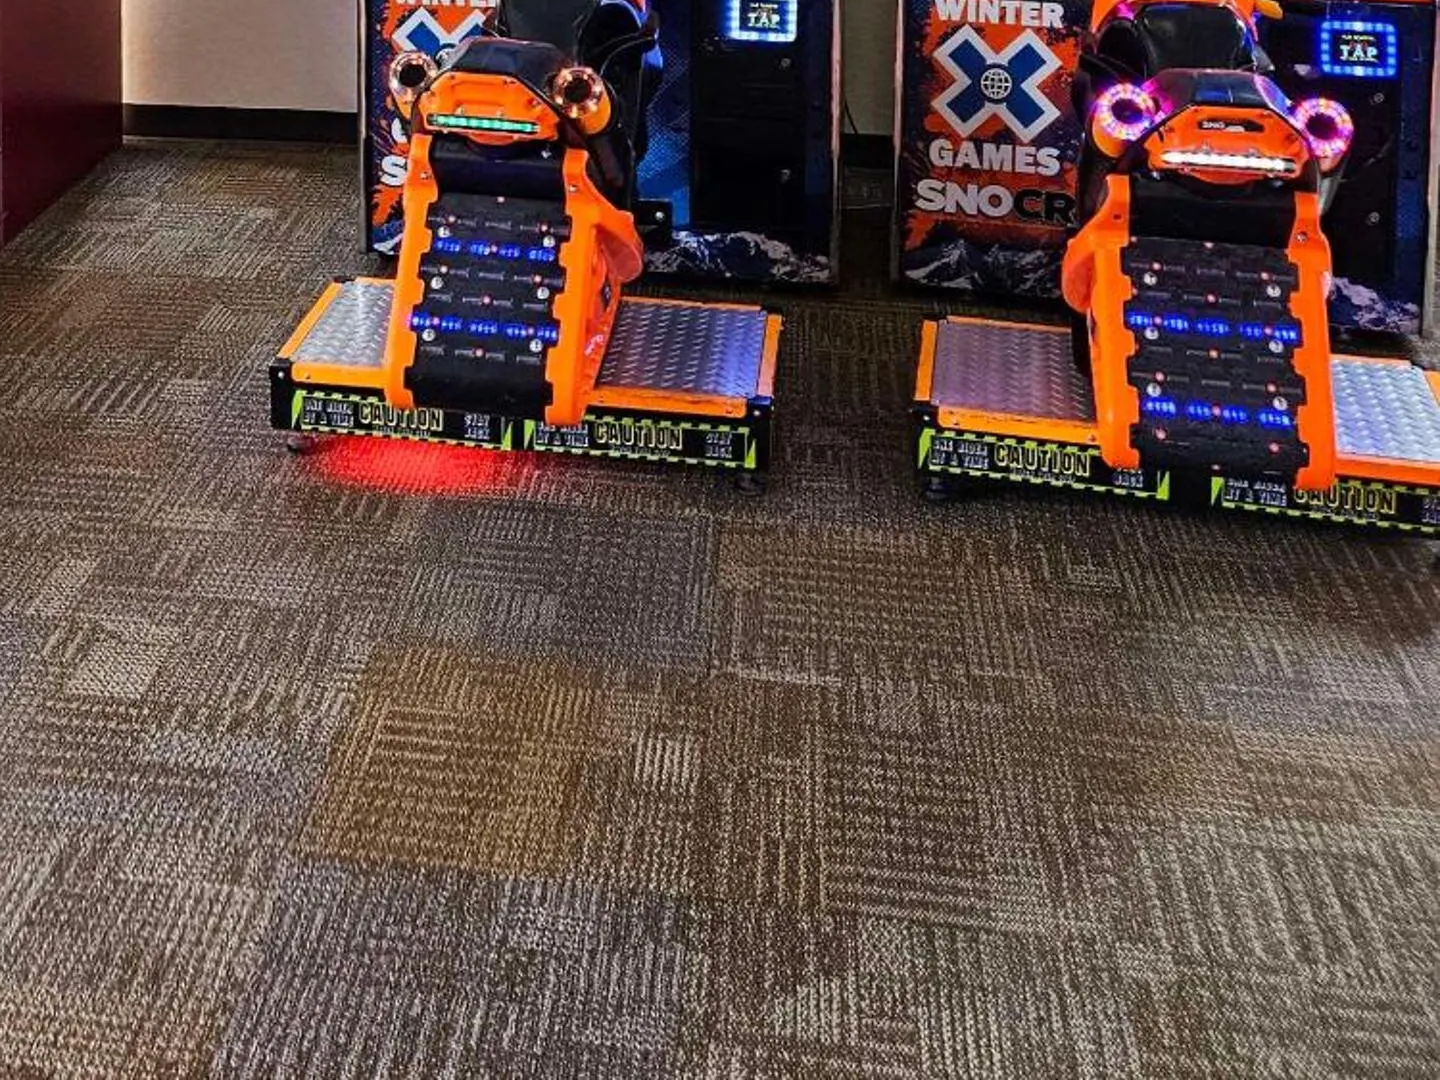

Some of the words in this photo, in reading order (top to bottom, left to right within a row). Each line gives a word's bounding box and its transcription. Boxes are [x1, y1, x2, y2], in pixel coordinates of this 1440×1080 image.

[1340, 43, 1379, 61] TAP
[928, 138, 1061, 177] GAMES
[915, 178, 1078, 228] SNOCR
[359, 400, 444, 431] CAUTION
[595, 420, 683, 450] CAUTION
[994, 441, 1090, 477] CAUTION
[1293, 478, 1396, 515] CAUTION
